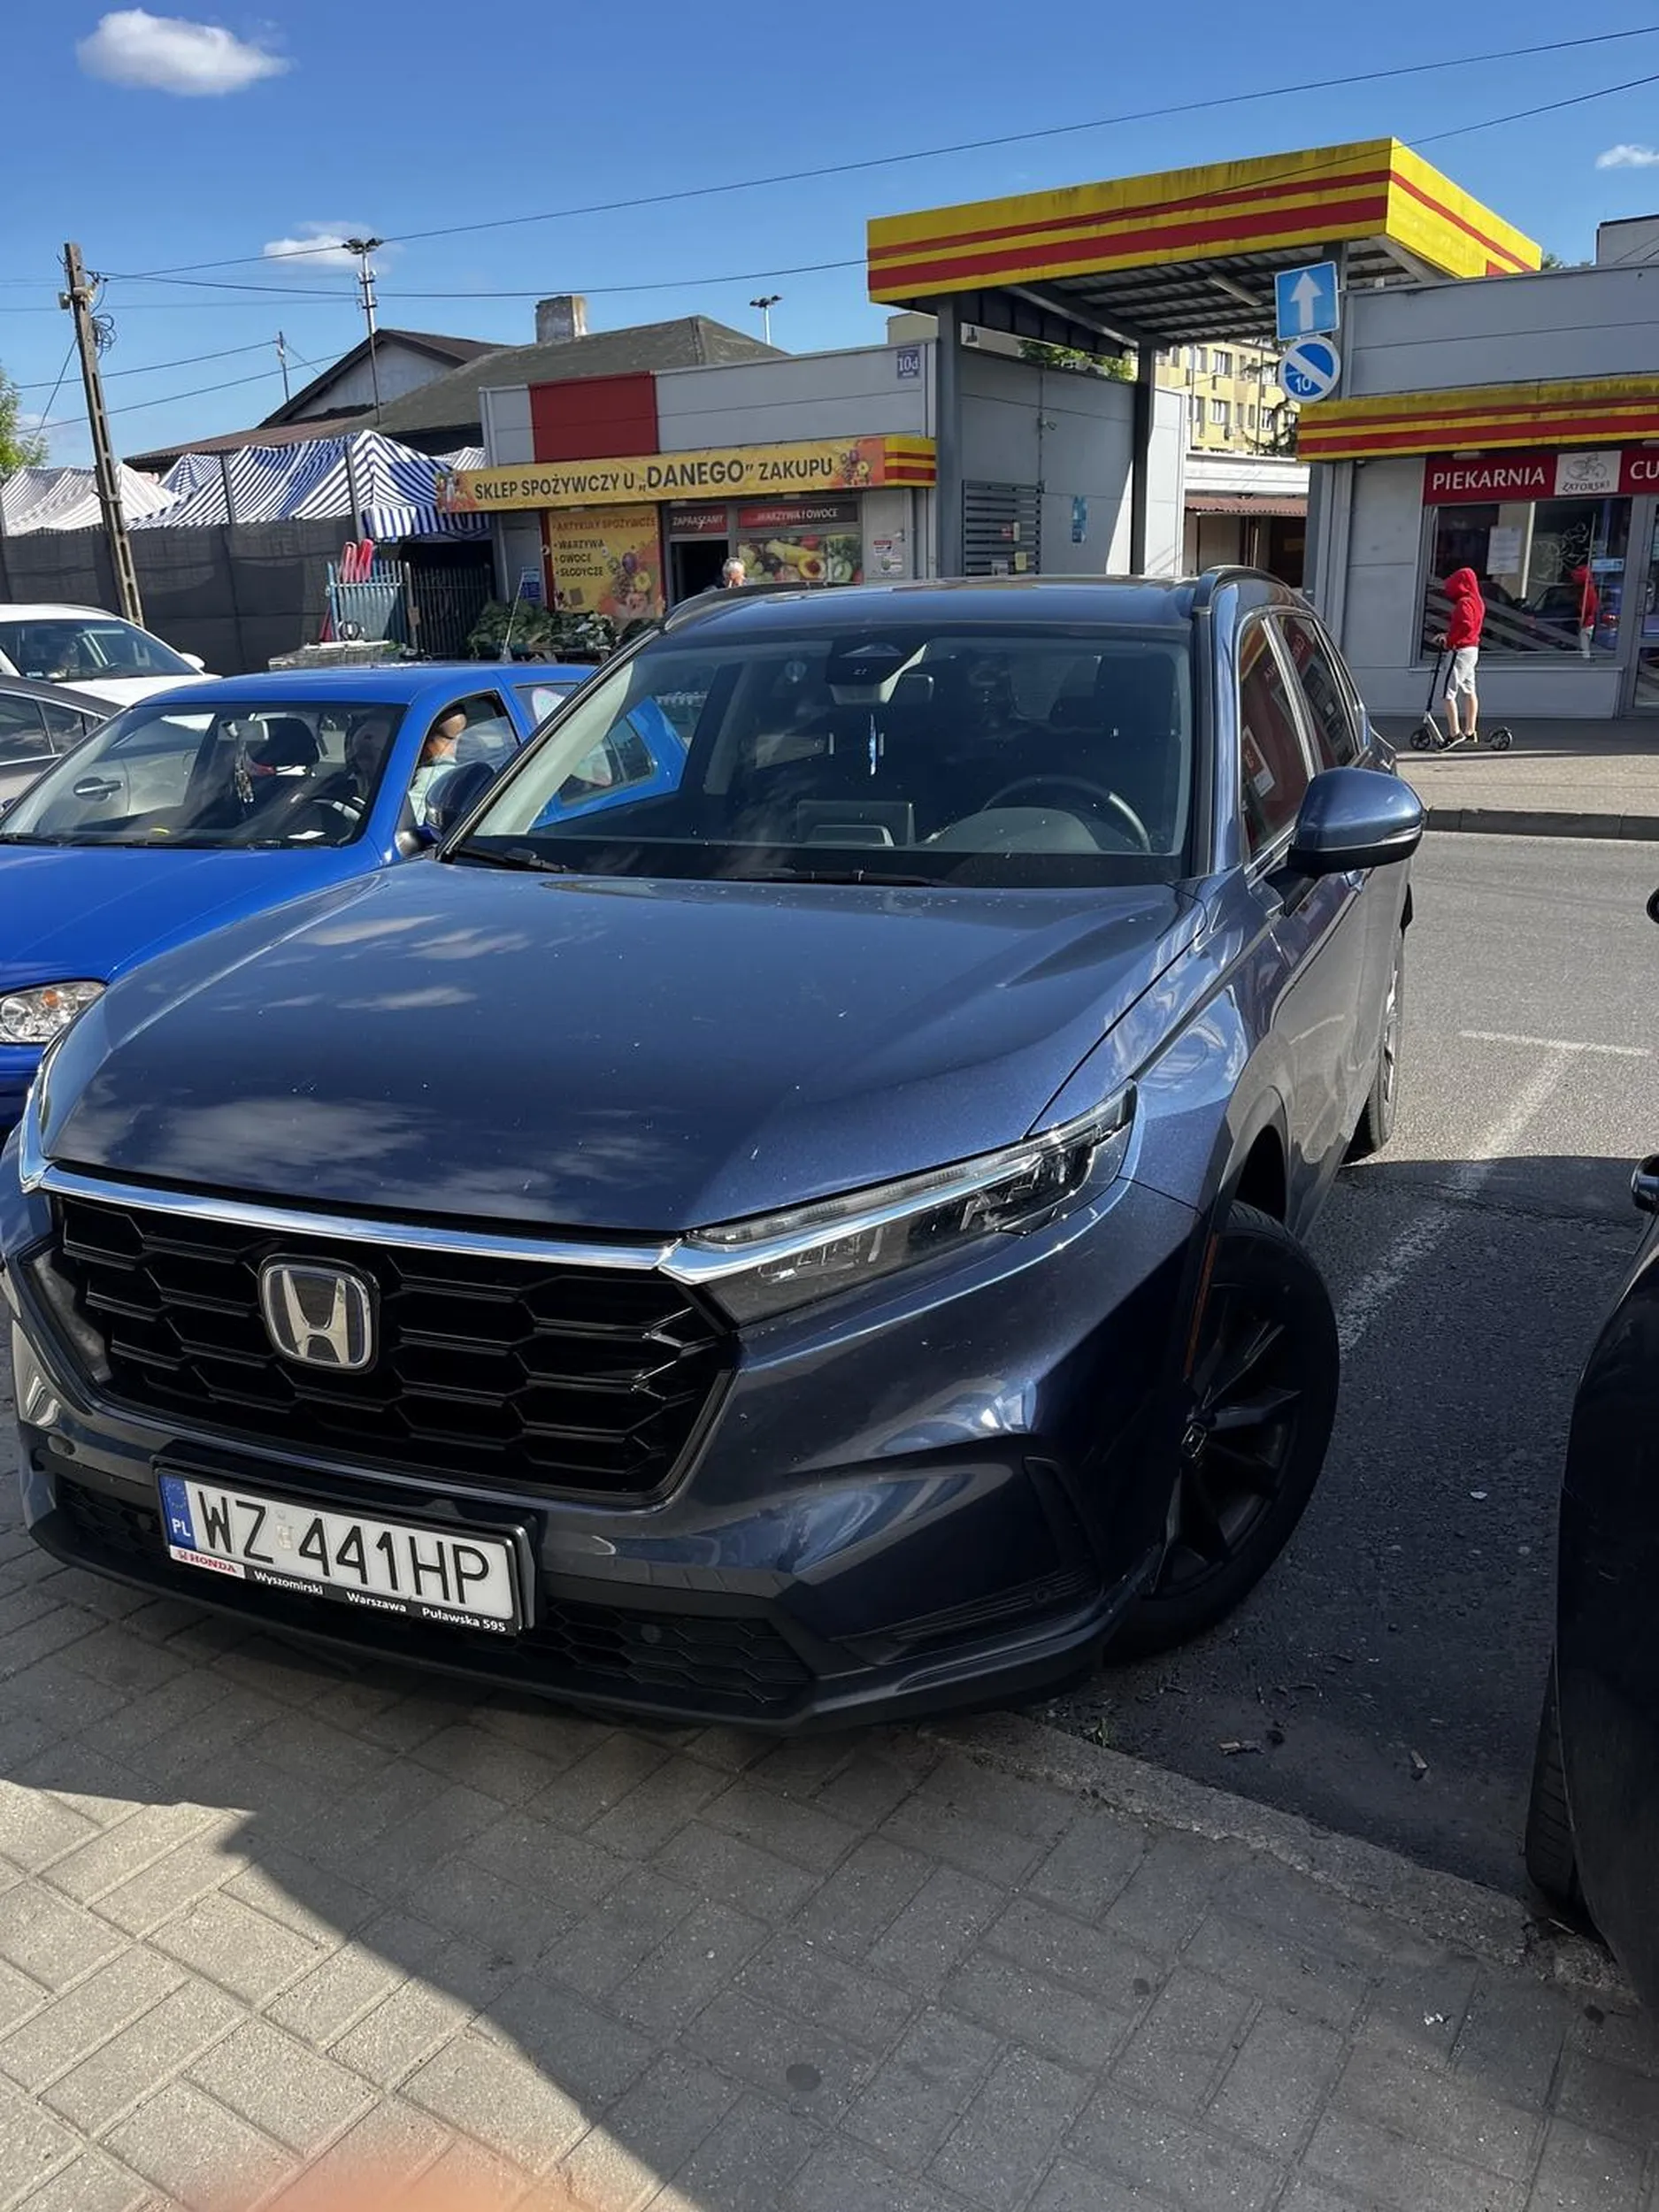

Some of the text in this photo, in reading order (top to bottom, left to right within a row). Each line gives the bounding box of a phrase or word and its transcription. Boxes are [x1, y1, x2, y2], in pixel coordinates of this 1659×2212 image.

[1295, 376, 1312, 393] 10
[475, 480, 517, 500] SKLEP
[522, 472, 619, 497] SPOŻYWCZY
[623, 472, 634, 489] U
[758, 457, 833, 480] ZAKUPU
[1432, 466, 1546, 491] PIEKARNIA
[806, 508, 839, 518] OWOCE
[172, 1518, 191, 1538] PL
[197, 1491, 489, 1604] WZ 441HP
[189, 1554, 237, 1574] HONDA
[253, 1571, 506, 1632] Wyszomirski Warszawa Puławska 595
